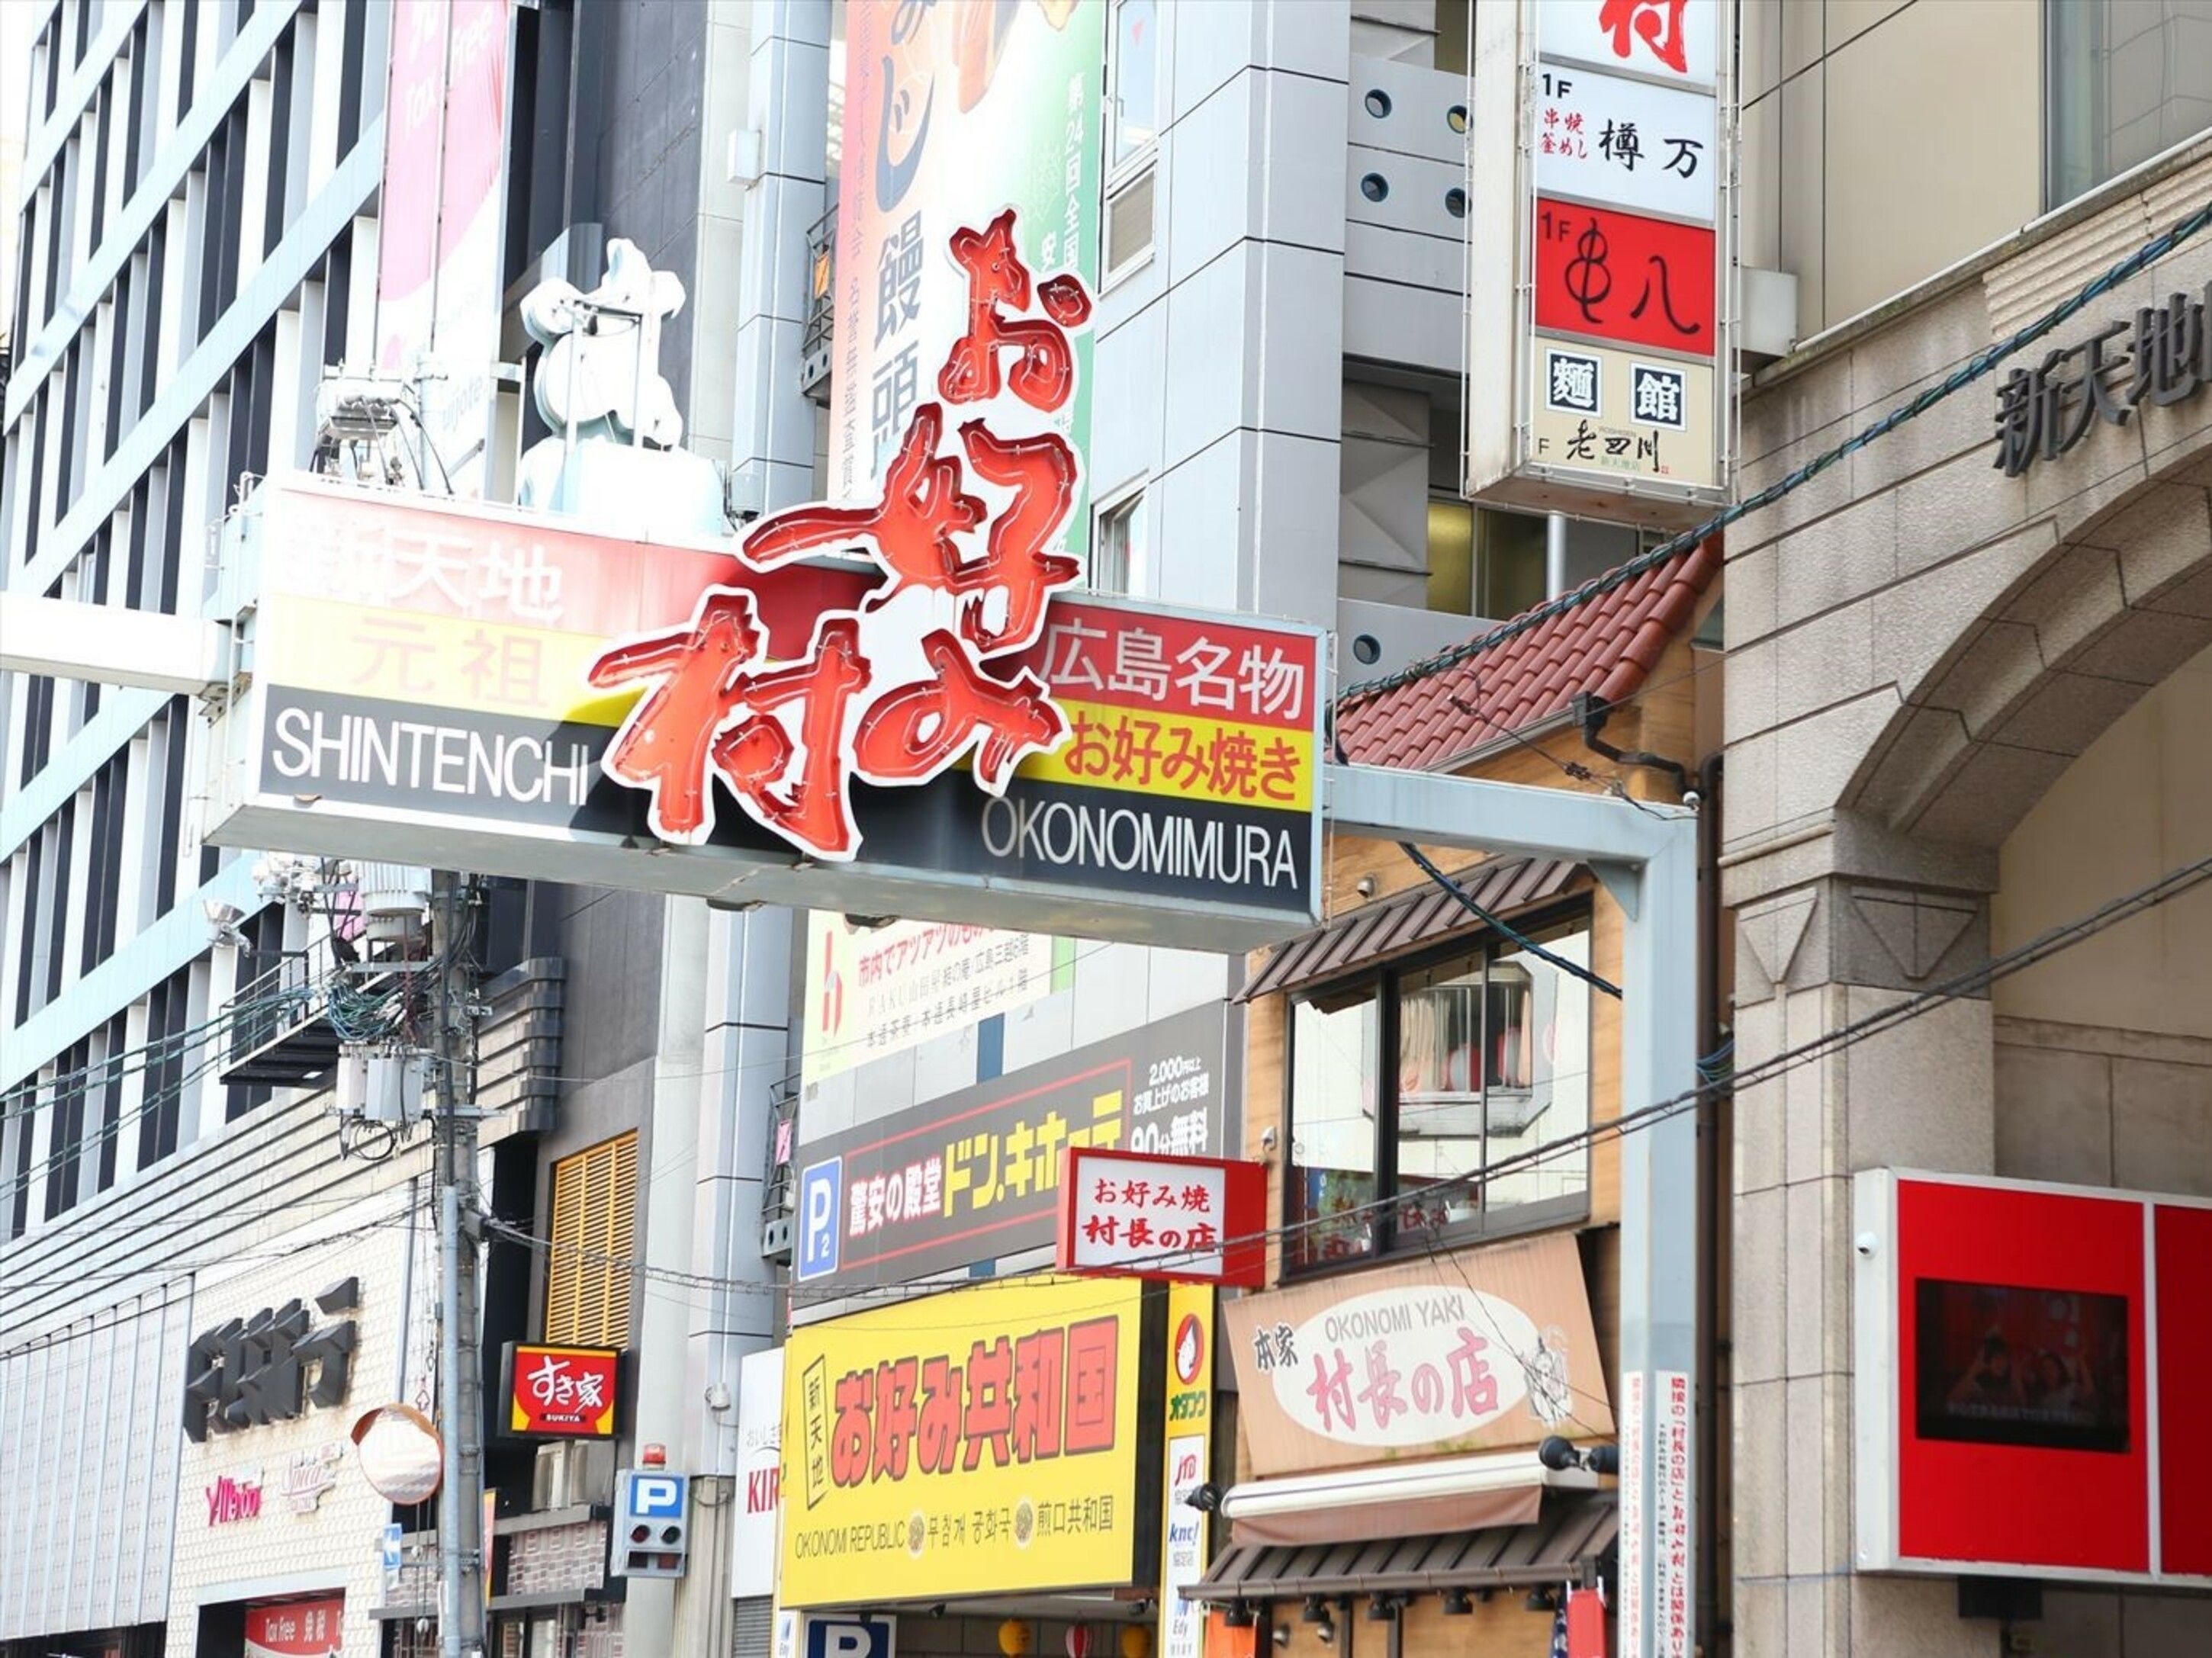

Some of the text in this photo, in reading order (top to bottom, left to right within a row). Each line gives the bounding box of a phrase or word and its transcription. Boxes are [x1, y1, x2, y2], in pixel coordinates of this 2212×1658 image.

[1542, 73, 1573, 99] 1F
[1540, 130, 1588, 159] 釜めし
[1543, 107, 1585, 136] 串焼
[1541, 210, 1572, 243] 1F
[1992, 281, 2212, 478] 新天地
[349, 615, 549, 709] 元祖
[1037, 618, 1305, 721] 広島名物
[272, 708, 589, 806] SHINTENCHI
[1063, 709, 1301, 802] お好み焼き
[981, 795, 1298, 890] OKONOMIMURA
[1094, 1177, 1210, 1213] お好み焼
[1082, 1214, 1217, 1253] 村長の店
[1324, 1293, 1466, 1344] OKONOMI YAKI
[1253, 1322, 1299, 1370] 本家
[526, 1354, 604, 1414] すき家
[830, 1314, 1120, 1489] お好み共和国
[1306, 1325, 1500, 1432] 村長の店
[545, 1413, 581, 1423] SUKIYA
[635, 1479, 678, 1515] P
[795, 1520, 906, 1560] OKONOMI REPUBLIC
